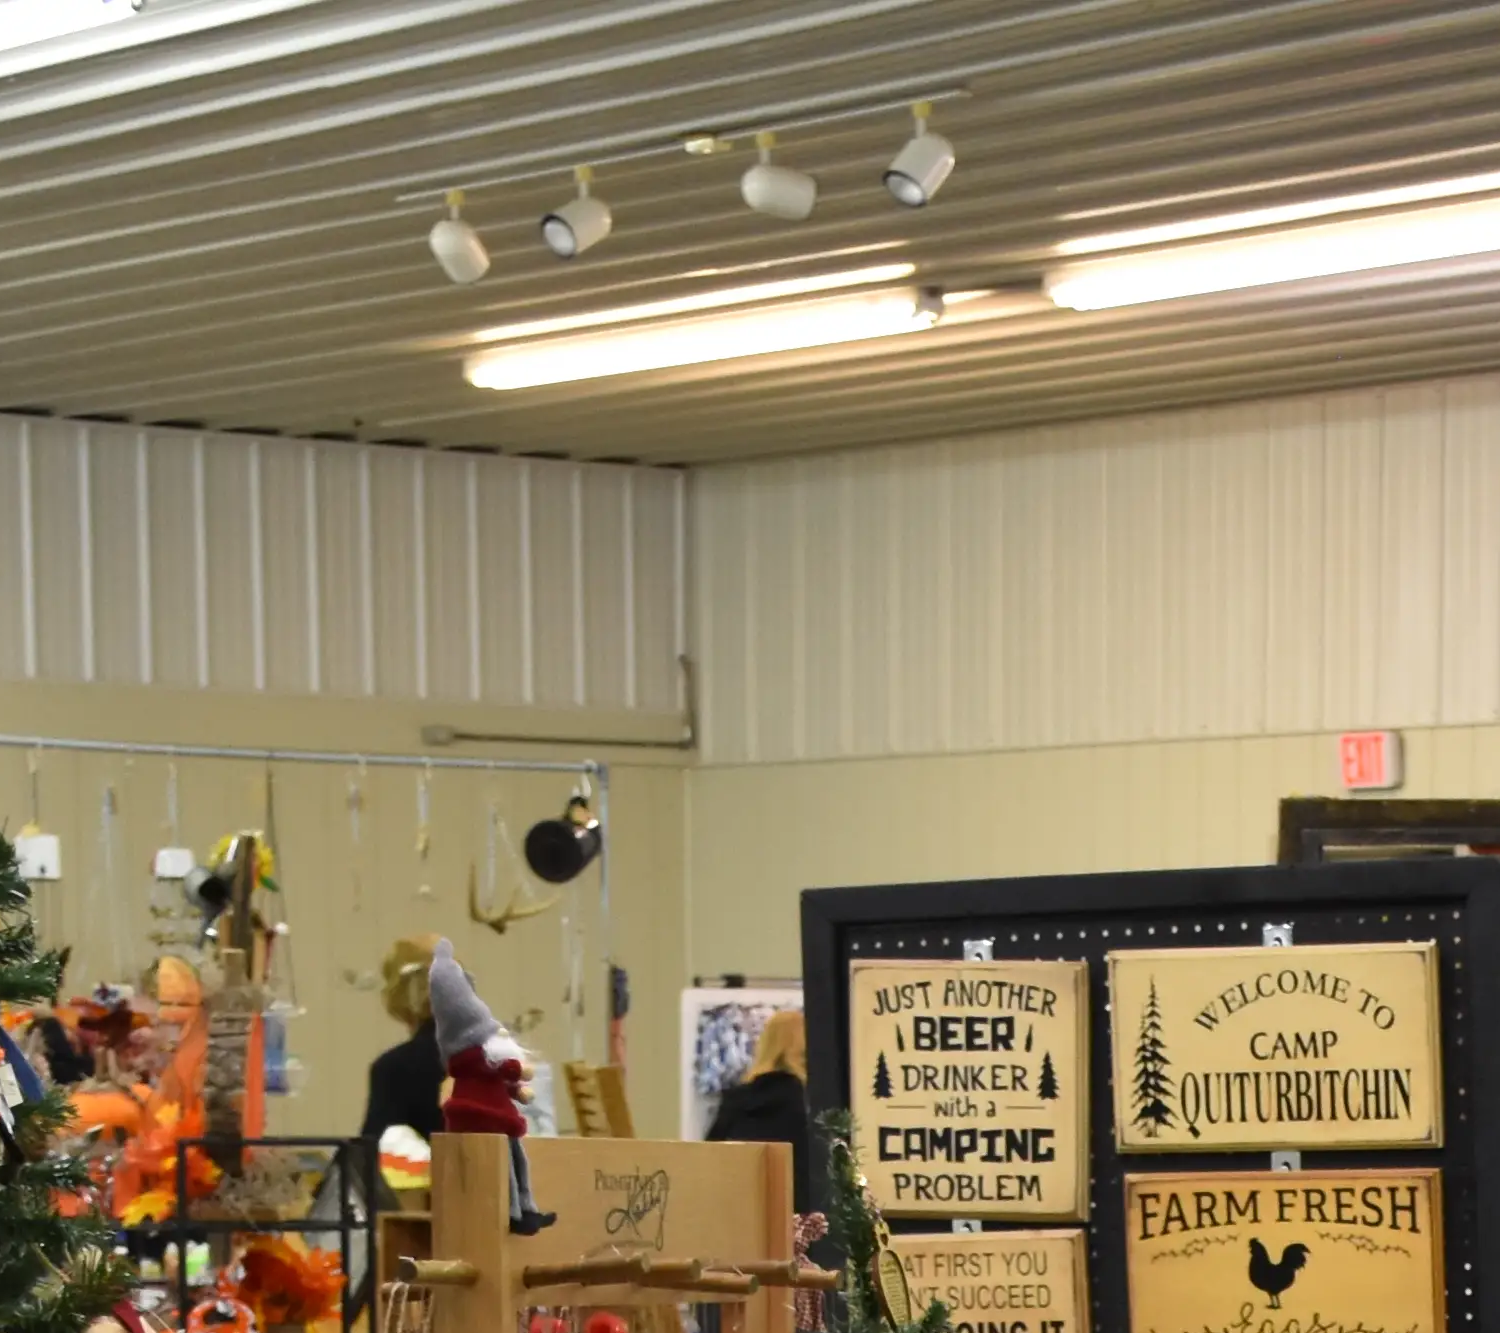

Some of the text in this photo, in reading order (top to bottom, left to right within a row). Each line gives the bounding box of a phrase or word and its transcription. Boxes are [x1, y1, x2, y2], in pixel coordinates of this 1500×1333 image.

[872, 979, 1058, 1018] JUST ANOTHER
[1192, 969, 1397, 1033] WELCOME TO
[913, 1016, 1016, 1052] BEER
[1249, 1030, 1338, 1061] CAMP
[901, 1063, 1029, 1093] DRINKER
[933, 1095, 998, 1119] with a
[1178, 1067, 1412, 1136] QUITURBITCHIN
[878, 1127, 1056, 1164] CAMPING
[893, 1174, 1042, 1204] PROBLEM
[1136, 1186, 1422, 1242] FARM FRESH
[934, 1252, 995, 1278] FIRST
[1002, 1251, 1048, 1277] YOU
[949, 1285, 1051, 1310] SUCCEED
